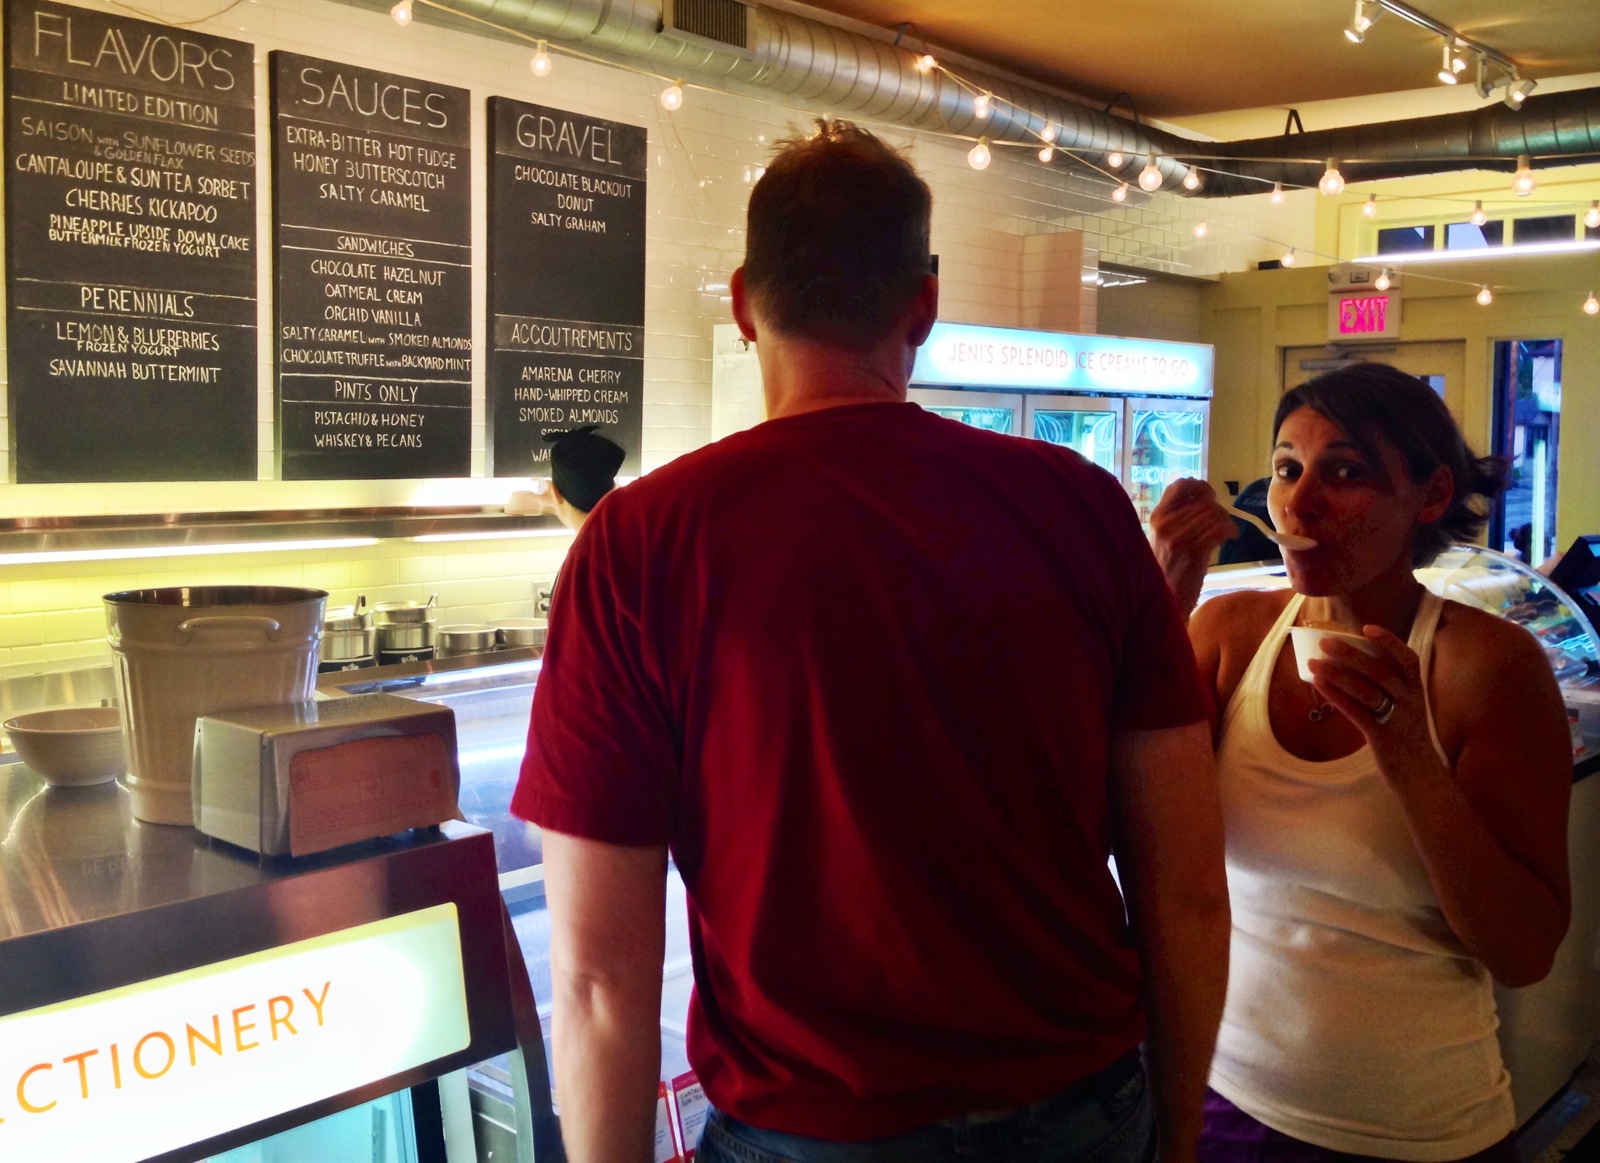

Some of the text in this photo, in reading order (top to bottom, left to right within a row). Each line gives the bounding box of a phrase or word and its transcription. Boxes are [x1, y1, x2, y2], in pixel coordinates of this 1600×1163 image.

[35, 12, 234, 90] FLAVORS
[63, 82, 218, 125] LIMITED EDITION
[300, 68, 447, 129] SAUCES
[22, 117, 93, 143] SAISON
[123, 132, 215, 160] SUNFLOWER
[220, 148, 256, 167] SEEDS
[287, 126, 456, 169] EXTRA-BITTER HOT FUDGE
[517, 113, 622, 165] GRAVEL
[104, 147, 151, 166] GOLDEN
[154, 154, 183, 170] FLAX
[293, 152, 445, 189] HONEY BUTTERSCOTCH
[16, 154, 250, 200] CANTALOUPE & SUN TEA SORBET
[515, 165, 631, 198] CHOCOLATE BLACKOUT
[66, 189, 217, 223] CHERRIES KICKAPOO
[320, 183, 430, 212] SALTY CARAMEL
[557, 194, 594, 212] DONUT
[50, 214, 249, 251] PINEAPPLE UPSIDE DOWN CAKE
[531, 212, 606, 233] SALTY GRAHAM
[49, 229, 220, 258] BUTTERMILK FROZEN YOGURT
[337, 236, 414, 257] SANDWICHES
[311, 260, 446, 286] CHOCOLATE HAZELNUT
[81, 286, 194, 317] PERENNIALS
[325, 283, 423, 305] OATMEAL CREAM
[325, 306, 422, 326] ORCHID VANILLA
[1340, 296, 1389, 334] EXIT
[57, 322, 220, 351] LEMON & BLUEBERRIES
[77, 341, 179, 357] FROZEN YOGURT
[283, 326, 316, 340] SALTY
[318, 328, 366, 344] CARAMEL
[389, 333, 429, 347] SMOKED
[431, 336, 472, 350] ALMONDS
[511, 323, 632, 350] ACCOUTREMENTS
[49, 359, 221, 383] SAVANNAH BUTTERMINT
[283, 349, 343, 364] CHOCOLATE
[345, 352, 385, 367] TRUFFLE
[401, 355, 444, 370] BACKYARD
[445, 358, 471, 371] MINT
[949, 343, 994, 364] JENI'S
[1002, 346, 1068, 369] SPLENDID
[1075, 351, 1094, 369] ICE
[1152, 357, 1167, 374] TO
[1171, 358, 1189, 376] GO
[522, 366, 621, 384] AMARENA CHERRY
[334, 380, 418, 403] PINTS ONLY
[514, 388, 628, 404] HAND-WHIPPED CREAM
[314, 412, 370, 426] PISTACHIO
[382, 414, 424, 427] HONEY
[519, 407, 619, 424] SMOKED ALMONDS
[314, 434, 365, 447] WHISKEY
[377, 434, 422, 448] PECANS
[0, 981, 331, 1124] CTIONERY
